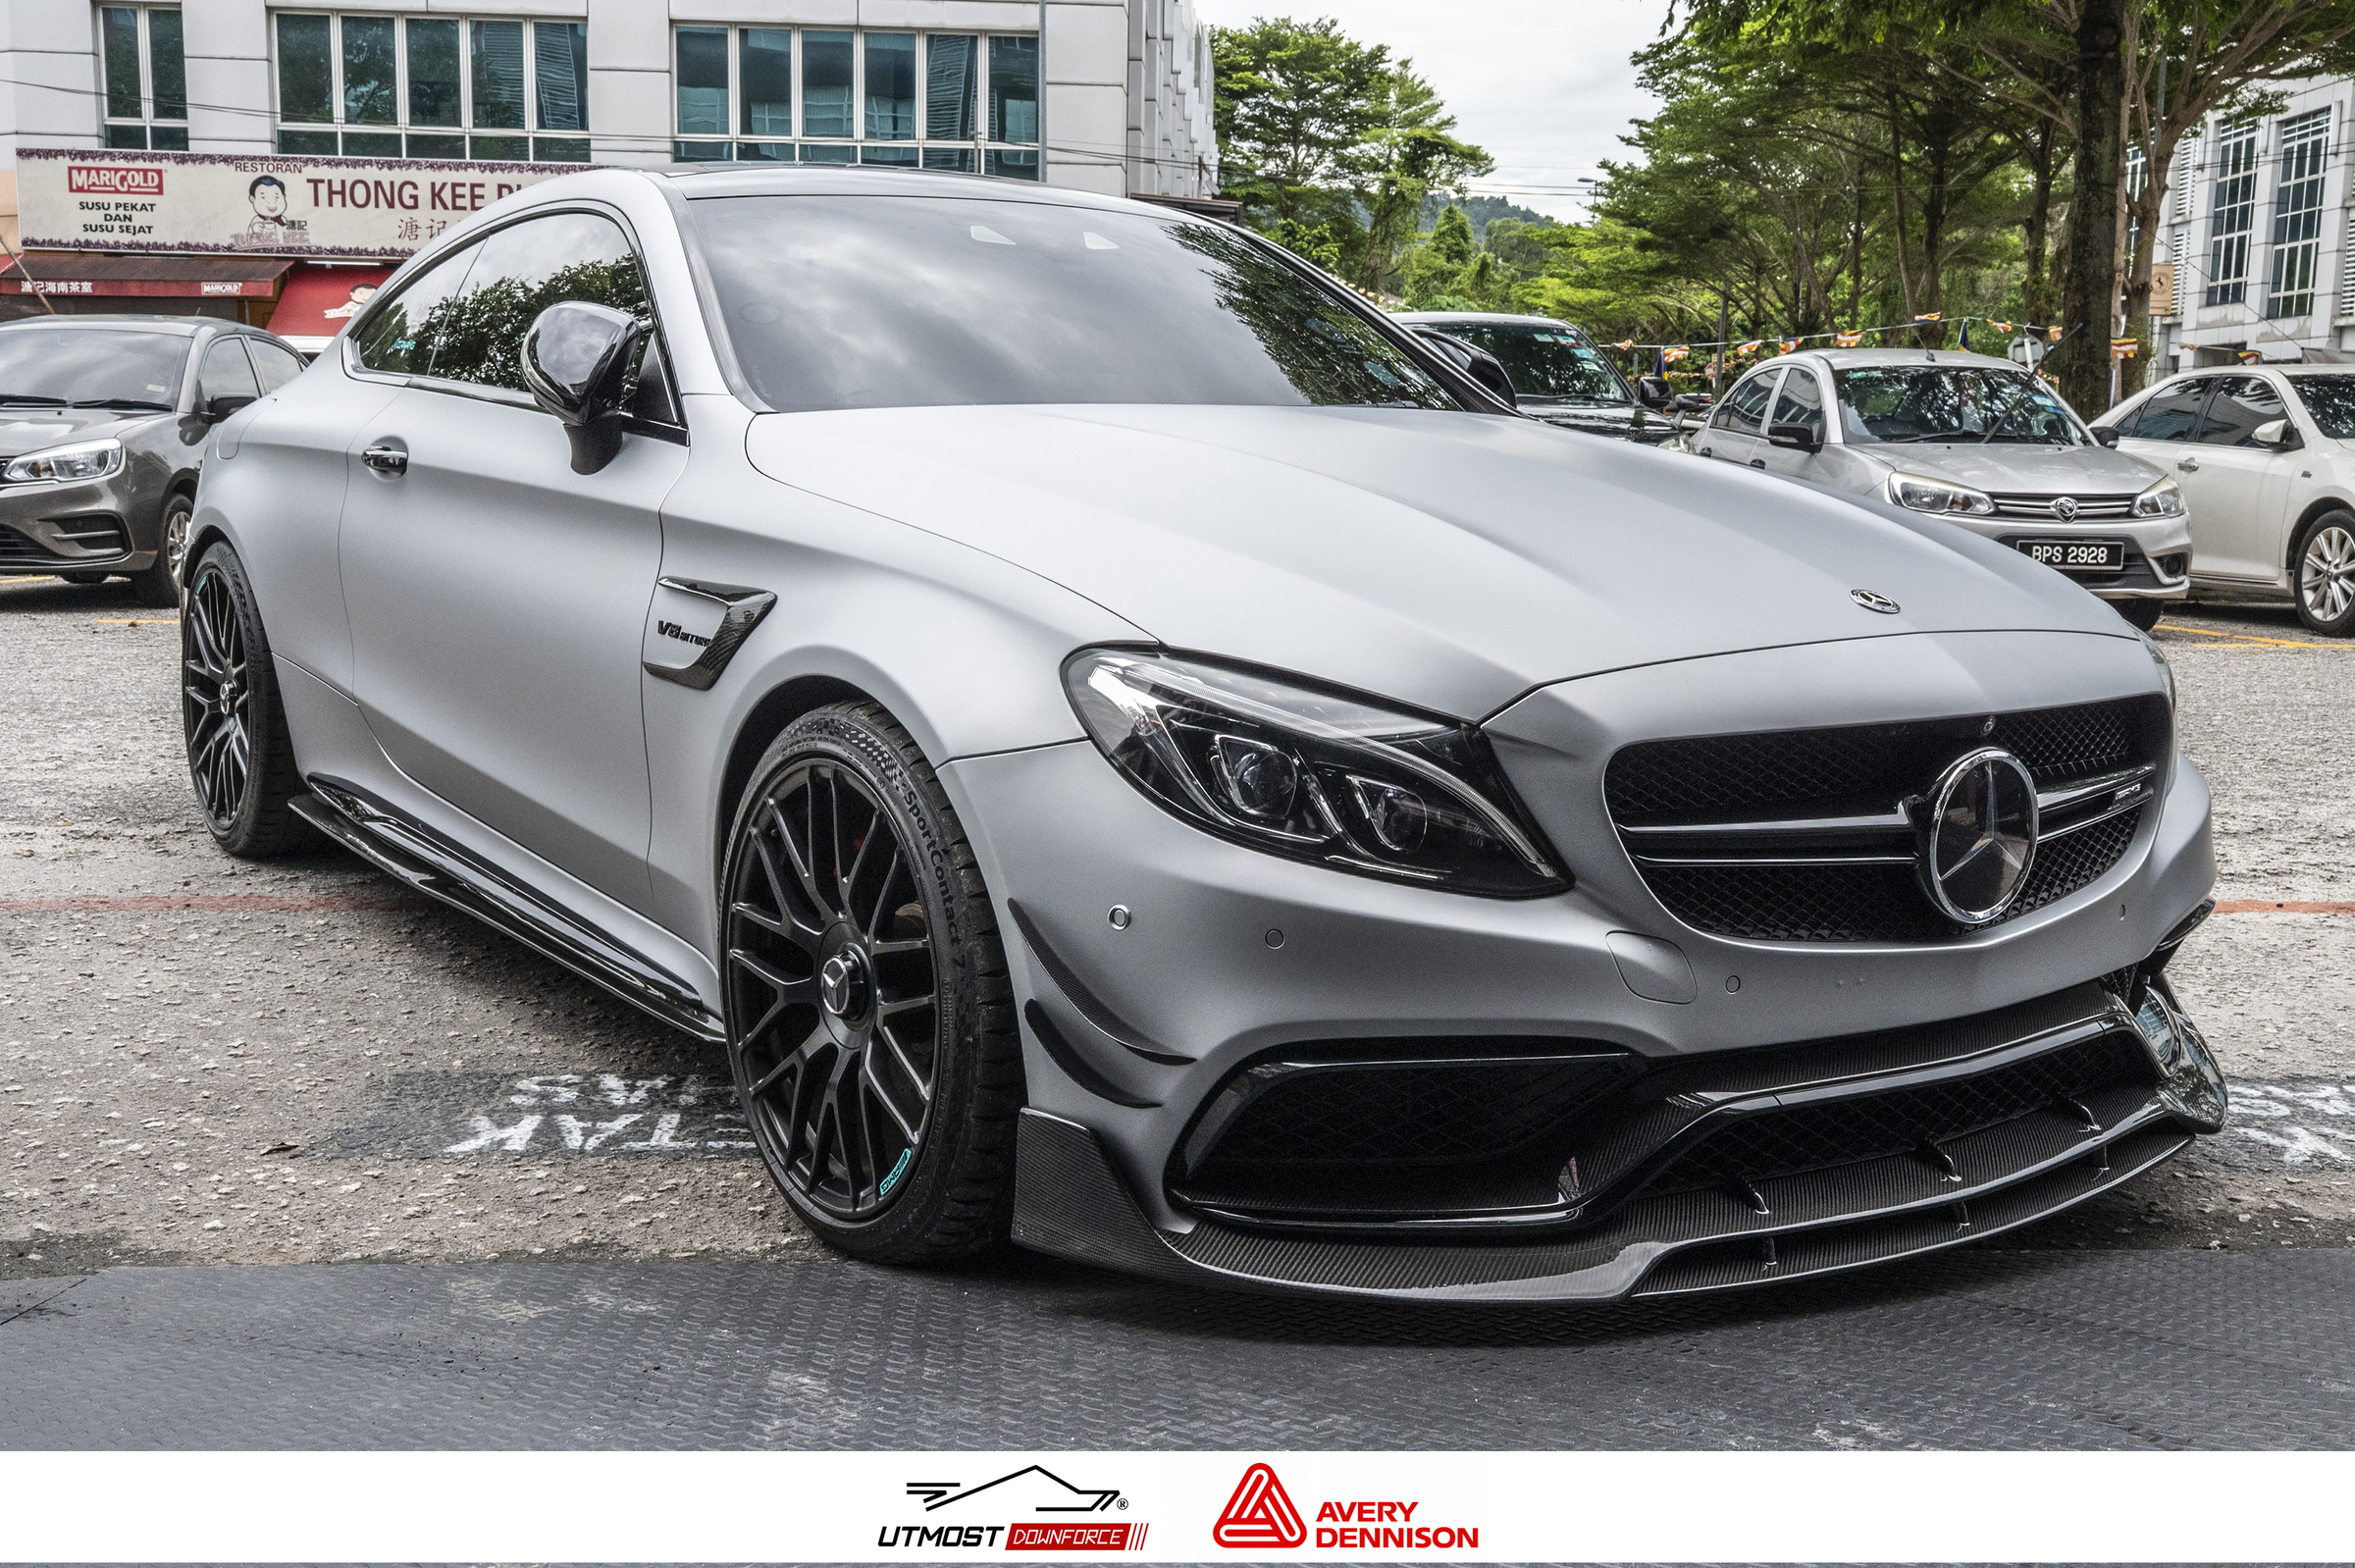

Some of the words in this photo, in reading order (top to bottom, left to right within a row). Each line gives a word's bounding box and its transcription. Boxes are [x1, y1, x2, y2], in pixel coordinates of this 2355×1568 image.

[235, 162, 302, 174] RESTORAN
[71, 169, 159, 192] MARIGOLD
[306, 178, 420, 210] THONG
[430, 182, 487, 211] KEE
[78, 201, 111, 211] SUSU
[115, 202, 156, 212] PEKAT
[104, 213, 132, 223] DAN
[82, 224, 114, 233] SUSU
[119, 225, 153, 235] SEJAT
[397, 217, 460, 241] 溏记
[232, 232, 279, 246] THONG
[283, 232, 311, 244] KEE
[203, 284, 238, 293] MARIGOLD
[2032, 546, 2063, 562] BPS
[2067, 547, 2108, 563] 2928
[904, 791, 962, 946] SportContact
[953, 955, 966, 969] 7
